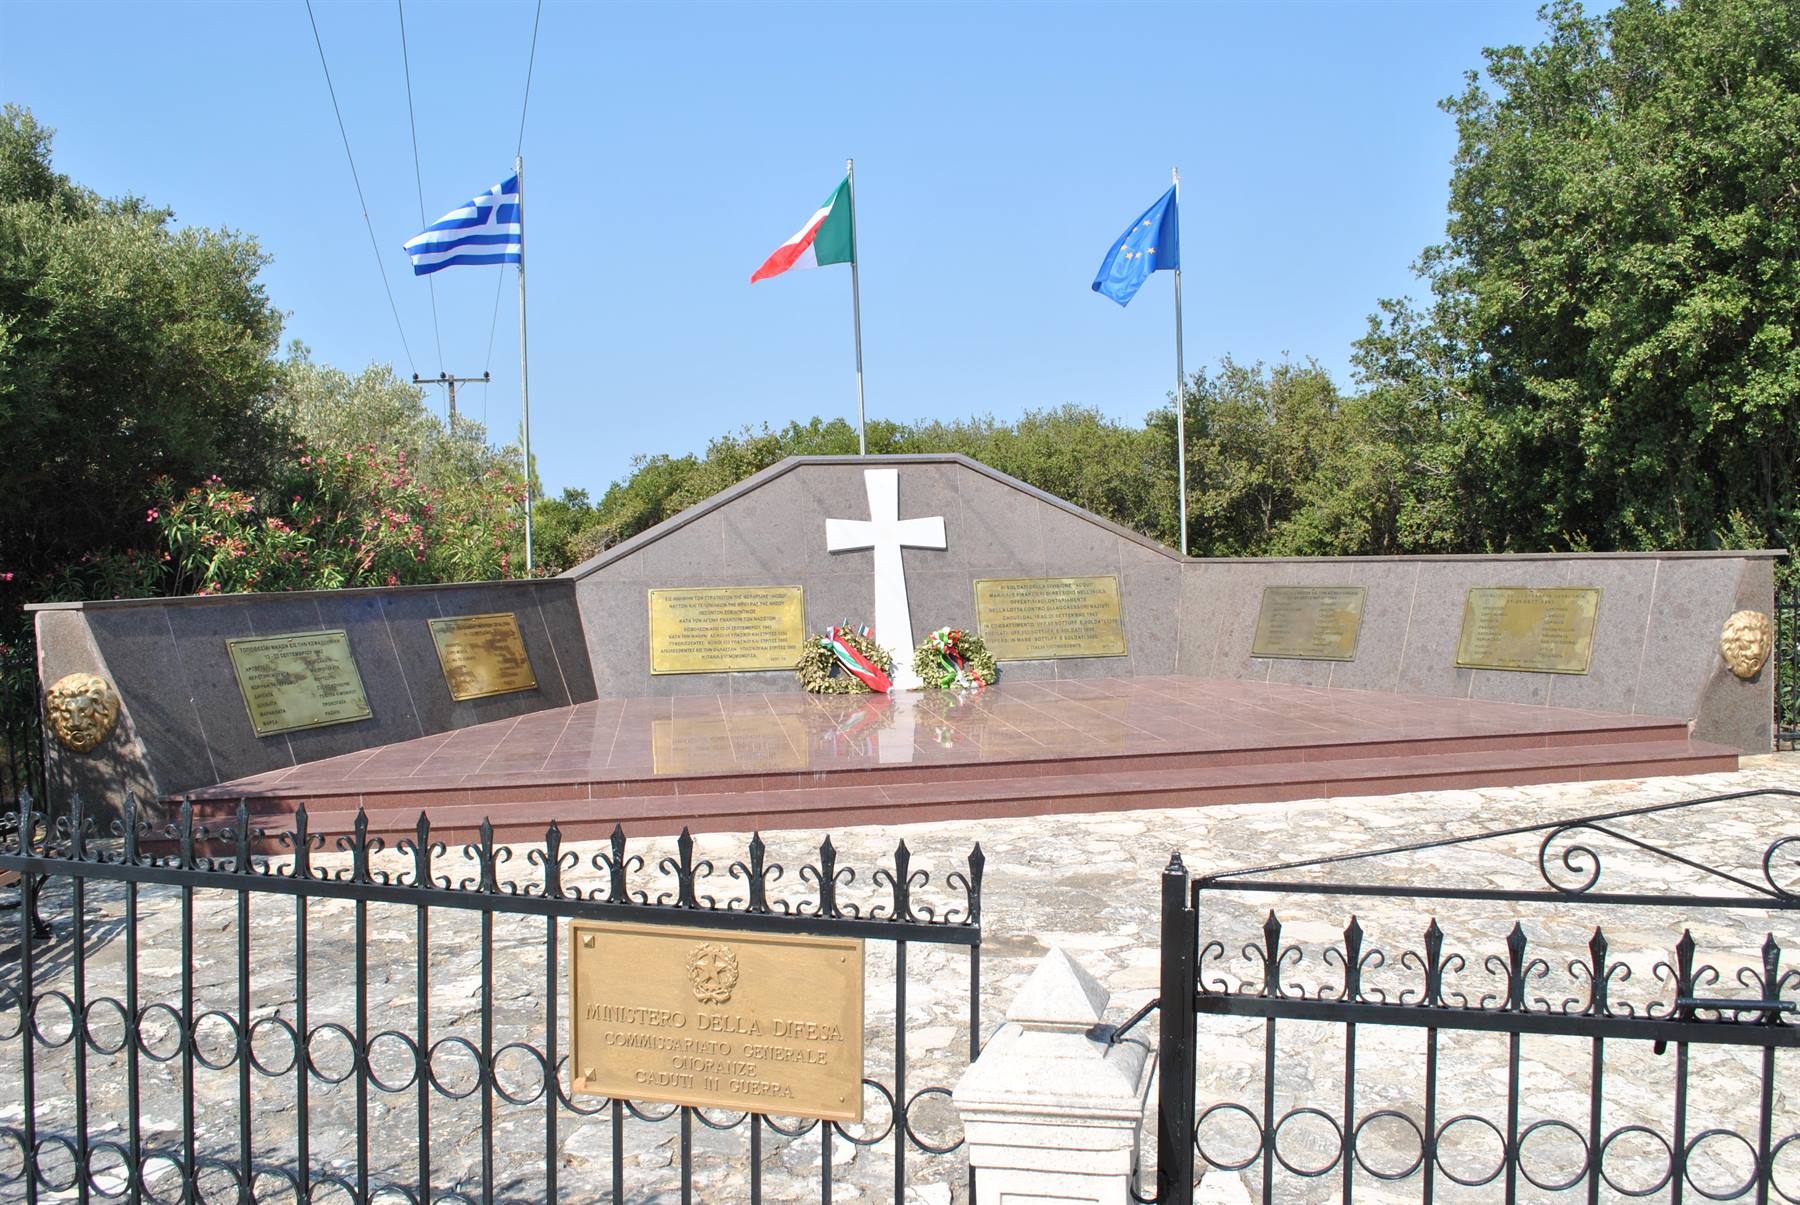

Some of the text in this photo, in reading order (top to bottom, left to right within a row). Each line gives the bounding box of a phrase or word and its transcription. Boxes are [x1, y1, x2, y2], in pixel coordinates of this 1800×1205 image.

[586, 1003, 845, 1042] MINISTERO DELLA DIFESA
[604, 1031, 829, 1066] COMMISSARIATO GENERALE
[672, 1055, 757, 1078] ONORANZE
[634, 1068, 796, 1099] CADUTI IN GUERRA
